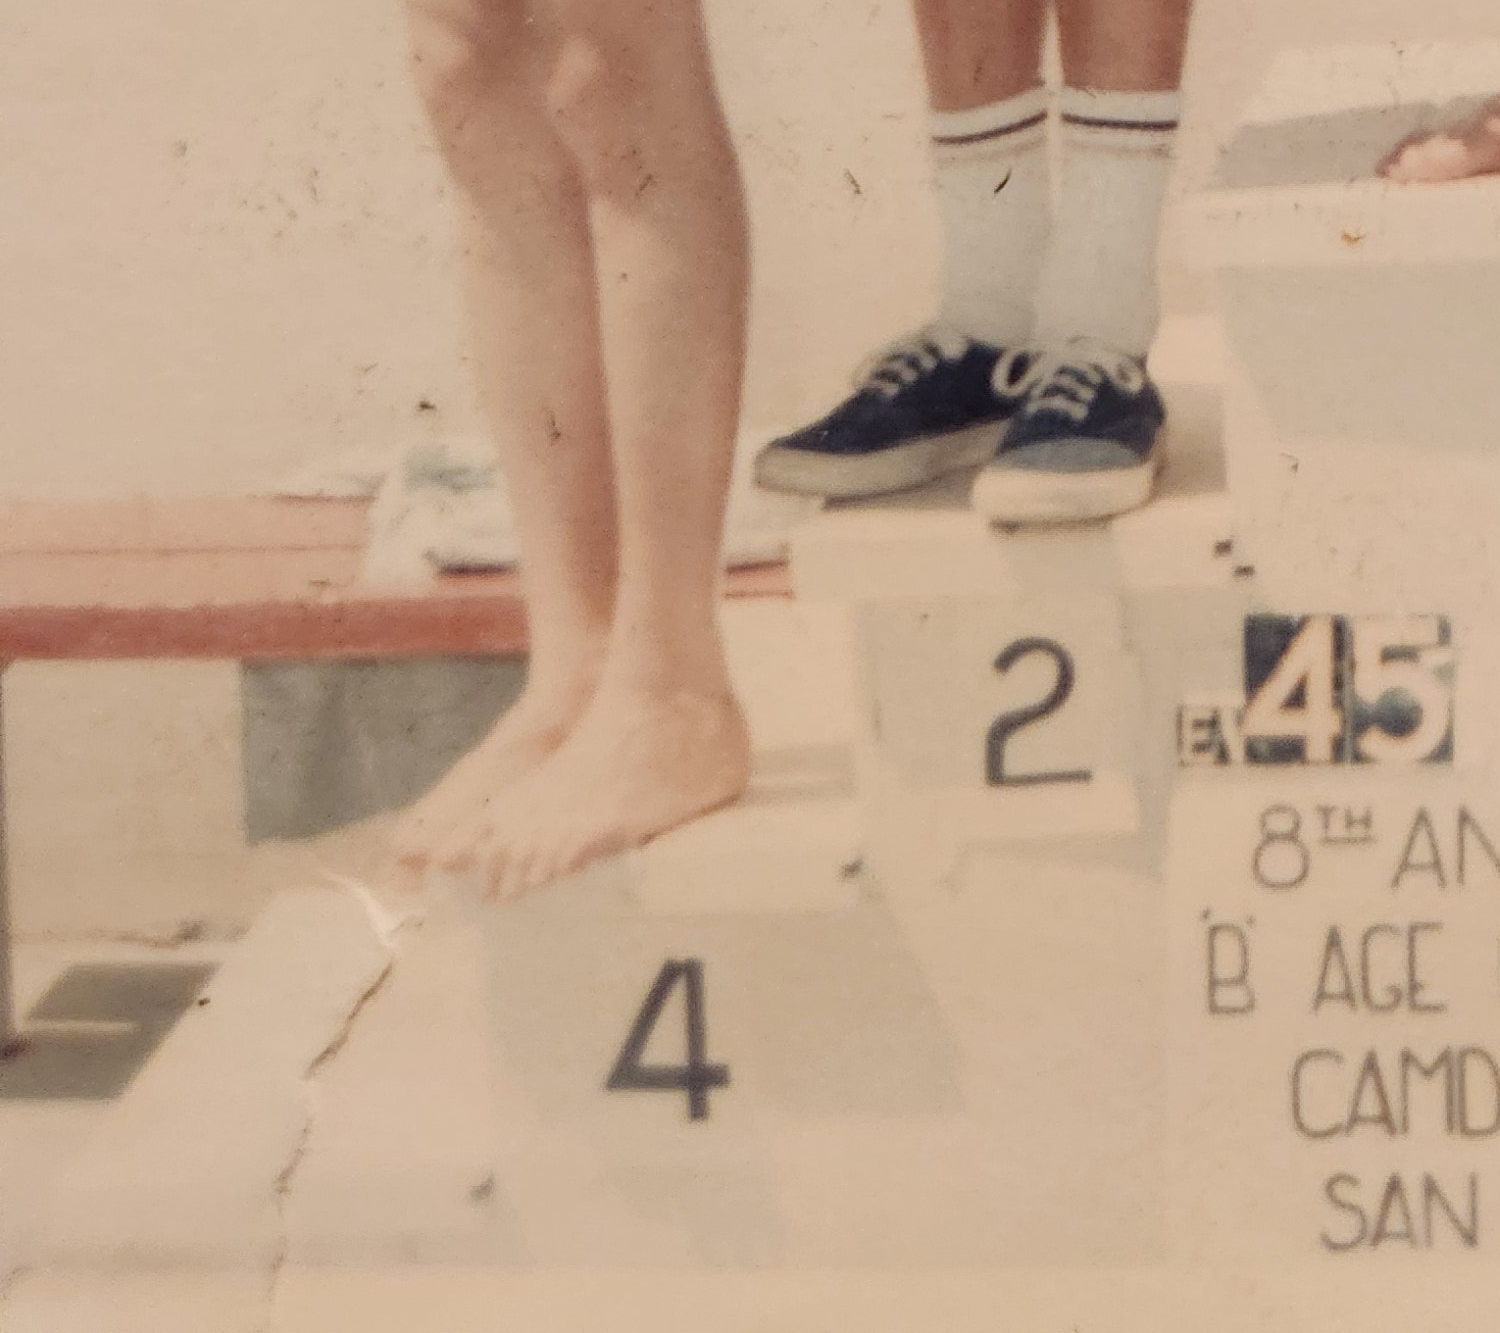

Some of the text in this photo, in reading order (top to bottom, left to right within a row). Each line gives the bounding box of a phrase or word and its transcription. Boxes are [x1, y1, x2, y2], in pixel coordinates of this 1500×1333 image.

[984, 637, 1093, 787] 2
[1245, 611, 1455, 765] 45
[605, 958, 731, 1122] 4
[1310, 921, 1449, 1015] AGE
[1318, 1168, 1481, 1253] SAN
